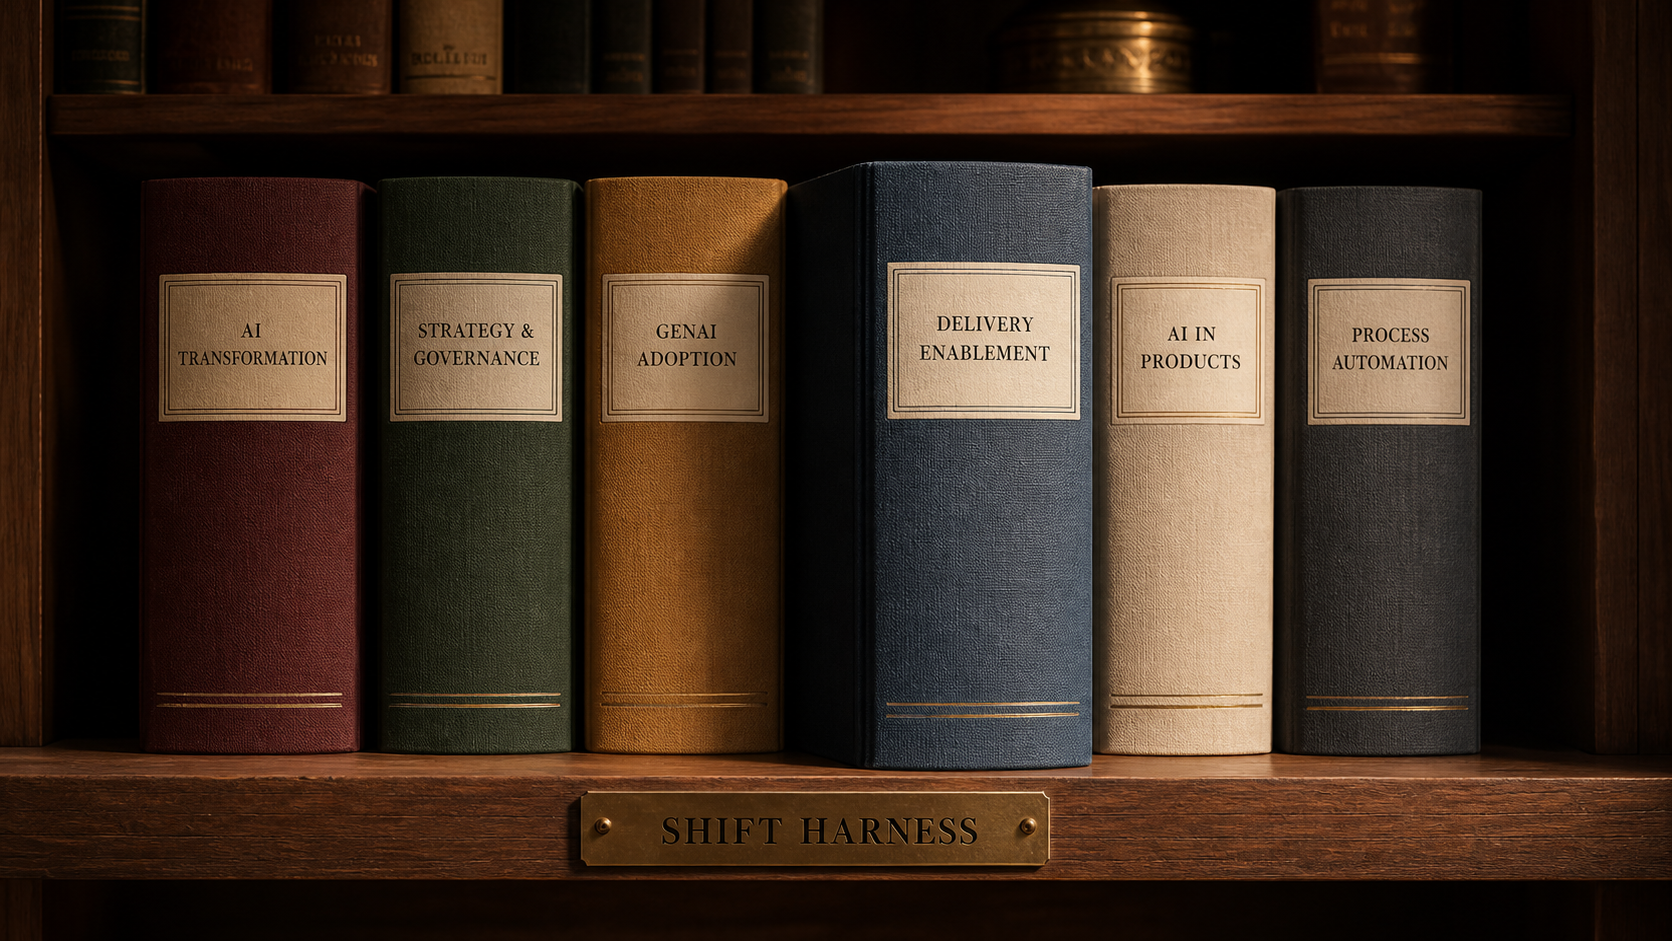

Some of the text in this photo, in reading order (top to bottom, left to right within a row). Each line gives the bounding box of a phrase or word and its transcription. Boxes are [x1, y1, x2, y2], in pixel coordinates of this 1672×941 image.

[241, 323, 262, 339] AI
[418, 323, 534, 339] STRATEGY &
[656, 323, 717, 340] GENAI
[937, 315, 1034, 333] DELIVERY
[1168, 326, 1216, 342] AI IN
[1352, 327, 1430, 344] PROCESS
[178, 351, 328, 366] TRANSFORMATION
[414, 351, 540, 367] GOVERNANCE
[637, 351, 738, 367] ADOPTION
[919, 344, 1051, 362] ENABLEMENT
[1140, 353, 1241, 370] PRODUCTS
[1331, 354, 1449, 371] AUTOMATION
[662, 817, 979, 845] SHIFT HARNESS
